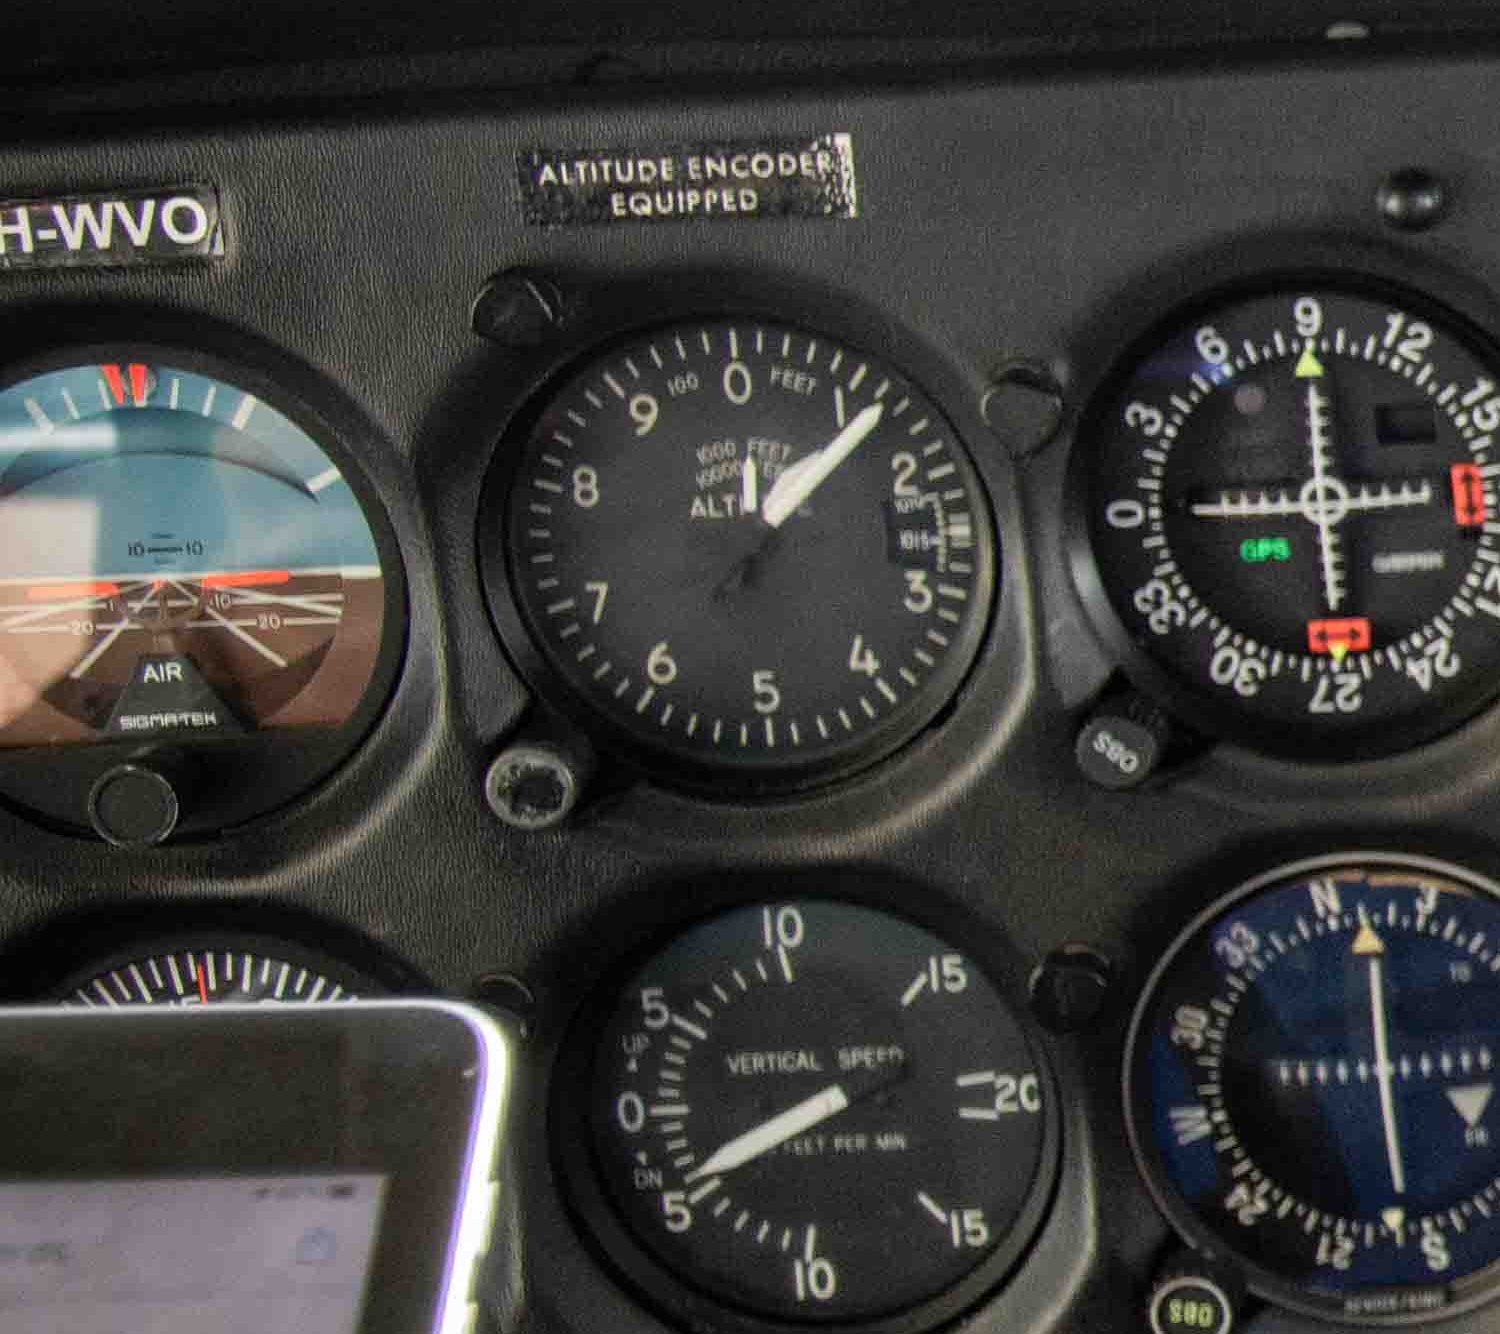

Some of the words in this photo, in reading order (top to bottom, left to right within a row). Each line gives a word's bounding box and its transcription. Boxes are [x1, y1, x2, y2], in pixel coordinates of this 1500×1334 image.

[537, 156, 675, 187] ALTITUDE
[687, 149, 837, 182] ENCODER
[611, 188, 759, 217] EQUIPPED
[1293, 296, 1324, 338] 9
[1382, 311, 1435, 363] 12
[1195, 326, 1229, 364] 6
[723, 360, 752, 405] 0
[770, 366, 818, 396] FEET
[629, 393, 659, 436] 9
[1125, 400, 1165, 439] 3
[572, 466, 599, 508] 8
[891, 452, 919, 497] 2
[1105, 497, 1143, 530] 0
[1239, 535, 1294, 564] GPS
[585, 581, 609, 624] 7
[904, 569, 933, 614] 3
[1134, 578, 1193, 638] 33
[142, 662, 184, 684] AIR
[647, 642, 678, 684] 6
[848, 634, 881, 678] 4
[1208, 645, 1268, 698] 30
[1405, 635, 1461, 692] 24
[752, 670, 780, 713] 5
[1308, 672, 1363, 714] 27
[1307, 879, 1342, 917] N
[760, 904, 806, 950] 10
[1214, 920, 1262, 968] 33
[928, 954, 969, 994] 15
[640, 986, 670, 1029] 5
[1170, 1004, 1210, 1051] 30
[725, 1050, 821, 1075] VERTICAL
[616, 1090, 646, 1134] 0
[991, 1073, 1042, 1114] 20
[661, 1191, 693, 1234] 5
[948, 1208, 990, 1248] 15
[1313, 1235, 1356, 1271] 21
[793, 1257, 837, 1303] 10
